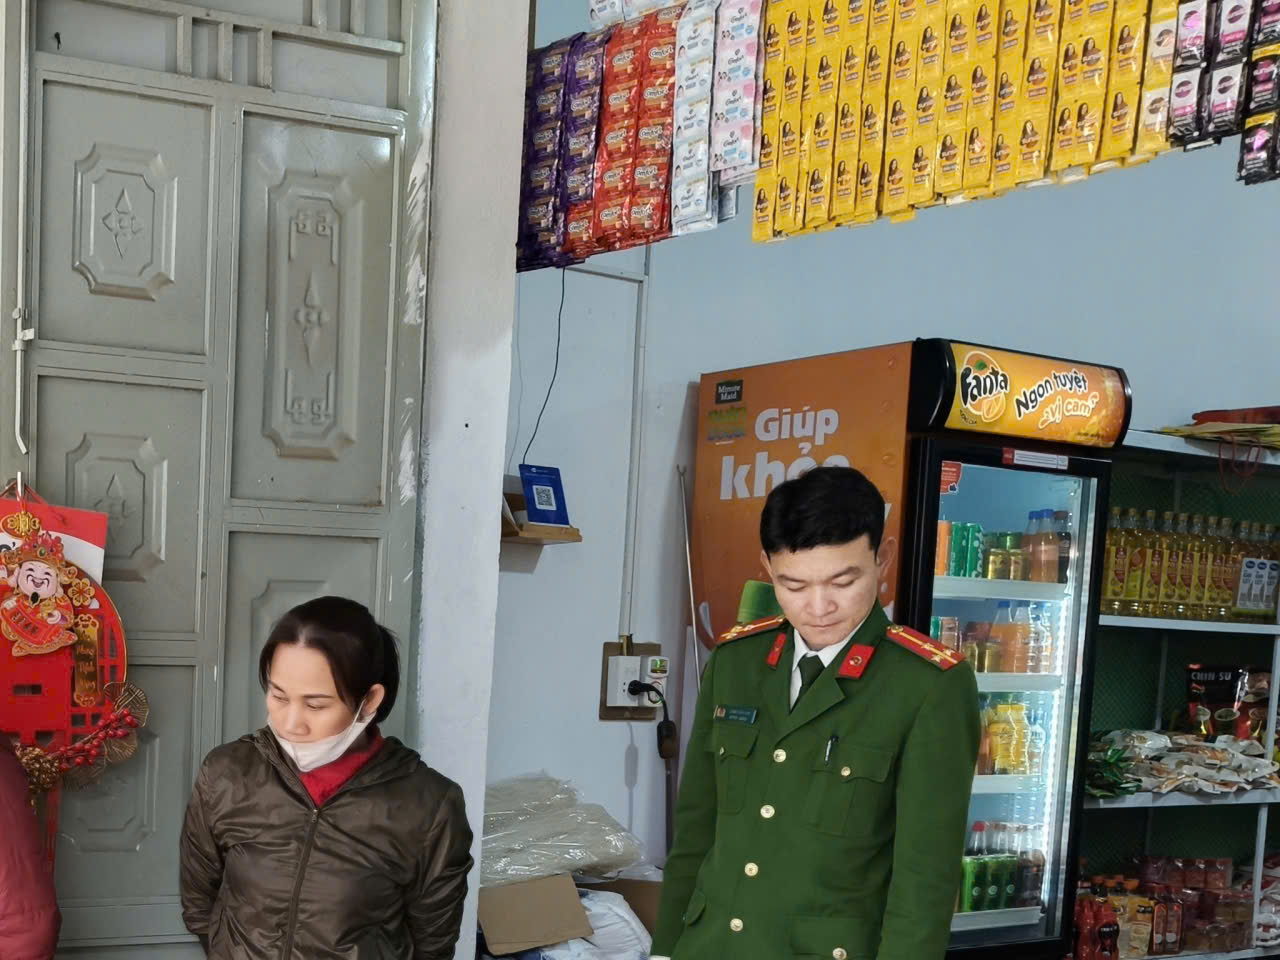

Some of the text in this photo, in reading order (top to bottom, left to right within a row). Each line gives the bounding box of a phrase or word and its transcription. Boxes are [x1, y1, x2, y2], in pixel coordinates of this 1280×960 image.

[960, 365, 1010, 408] Fanta
[1014, 378, 1053, 419] Ngon
[1052, 370, 1088, 393] tuyệt
[755, 405, 839, 446] Giúp
[720, 442, 851, 500] khỏ
